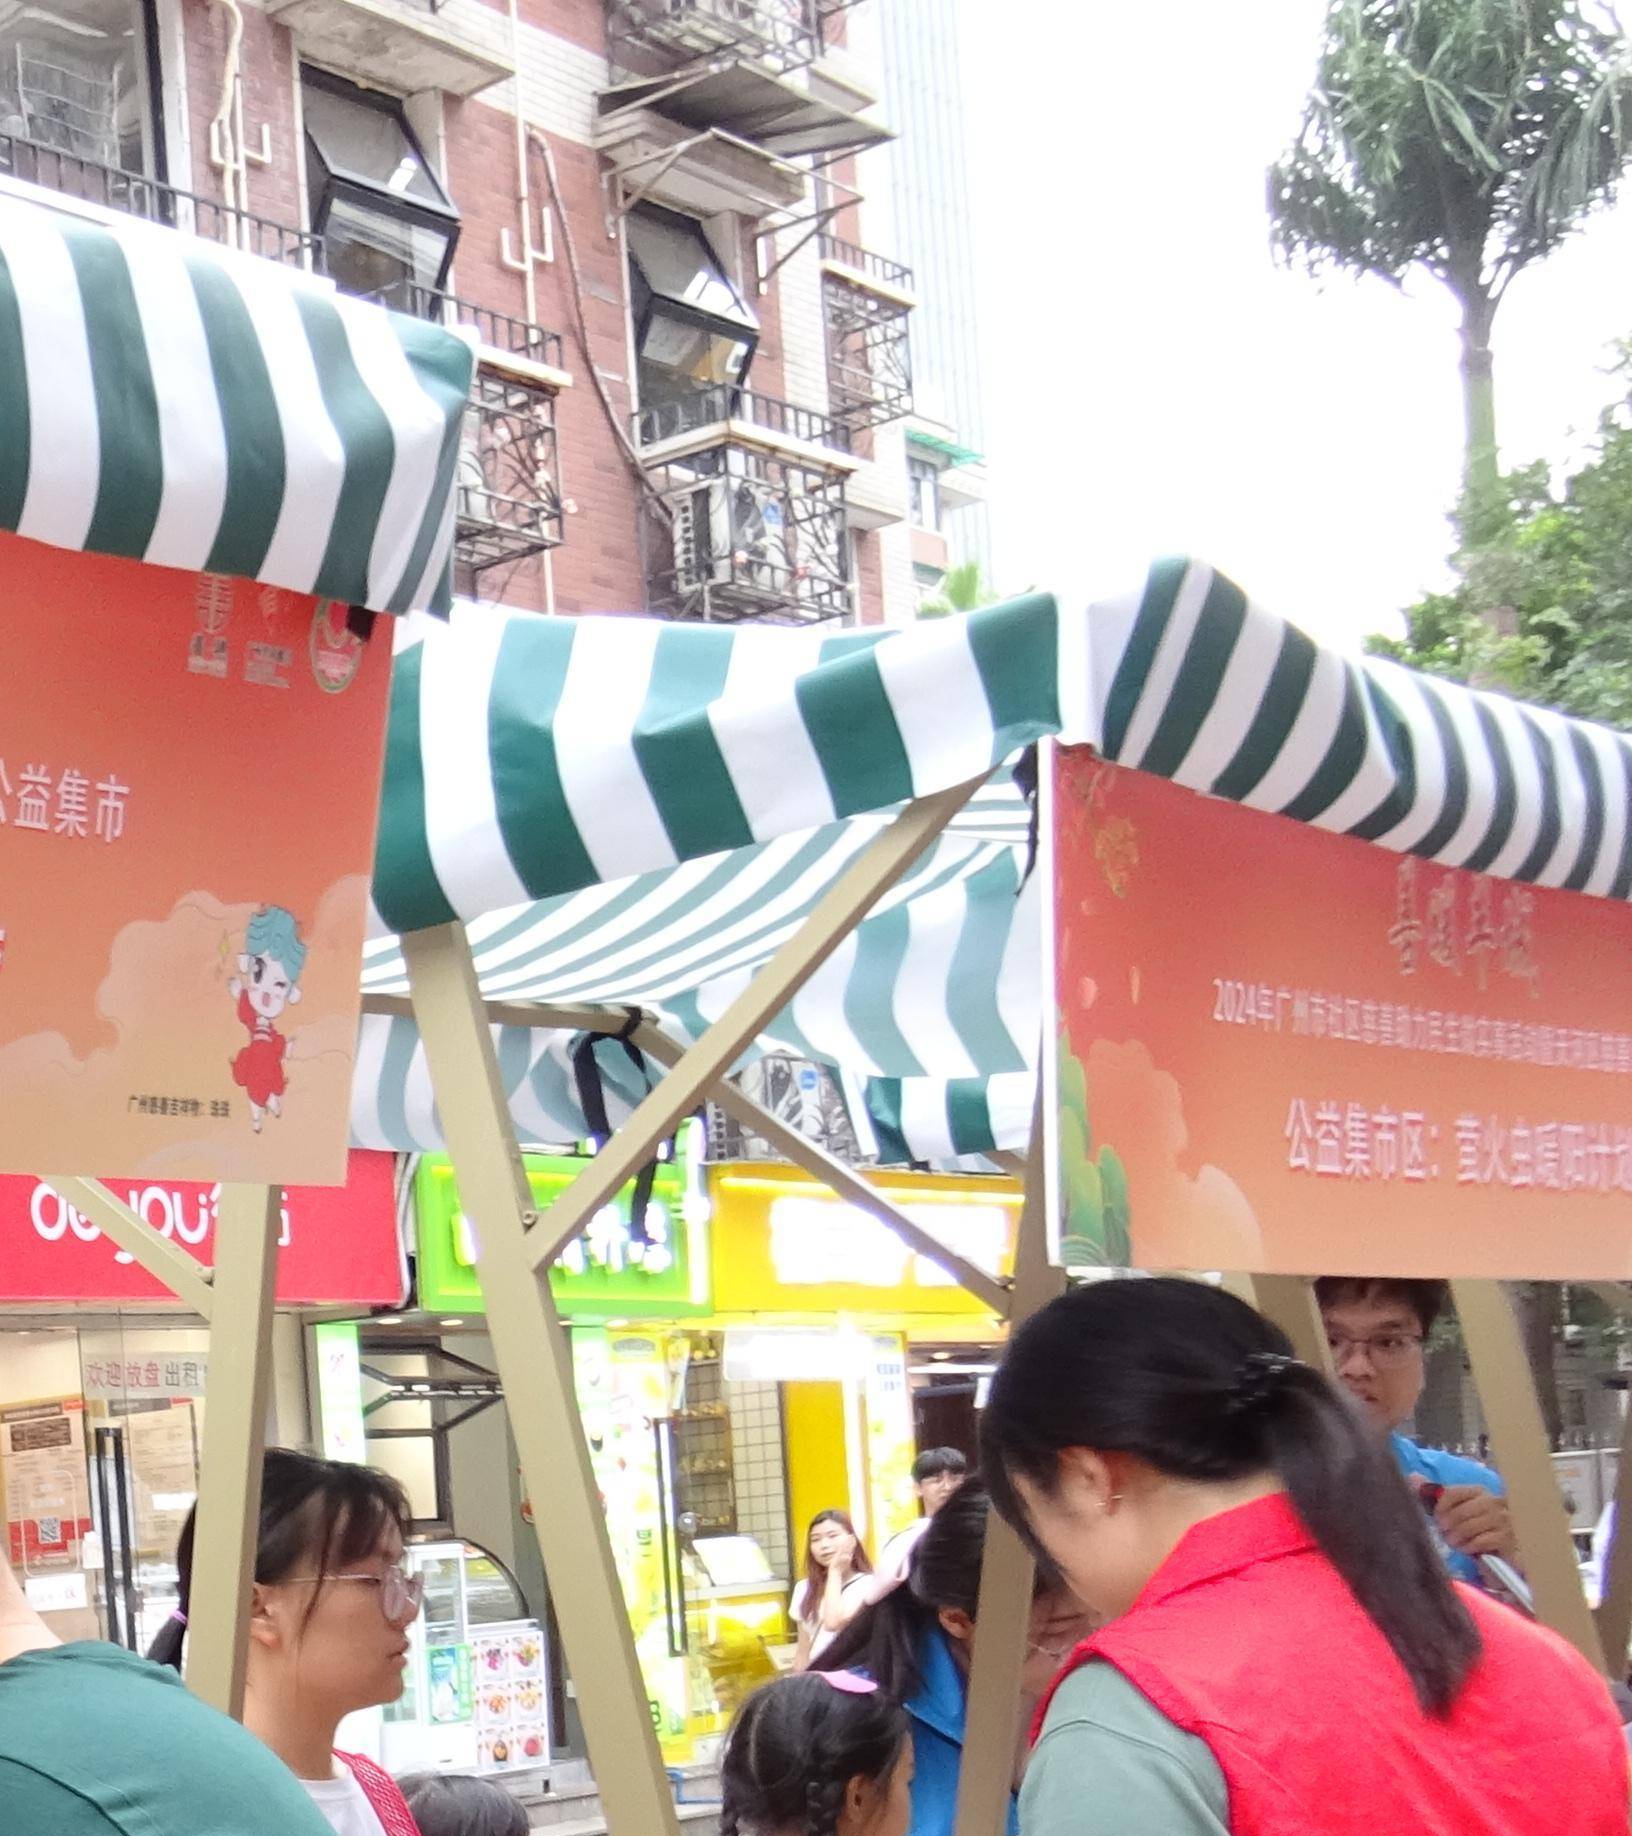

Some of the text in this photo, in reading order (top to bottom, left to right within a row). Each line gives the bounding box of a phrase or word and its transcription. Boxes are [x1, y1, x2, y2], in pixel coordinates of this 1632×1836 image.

[86, 1359, 207, 1388] 欢迎放盘出租
